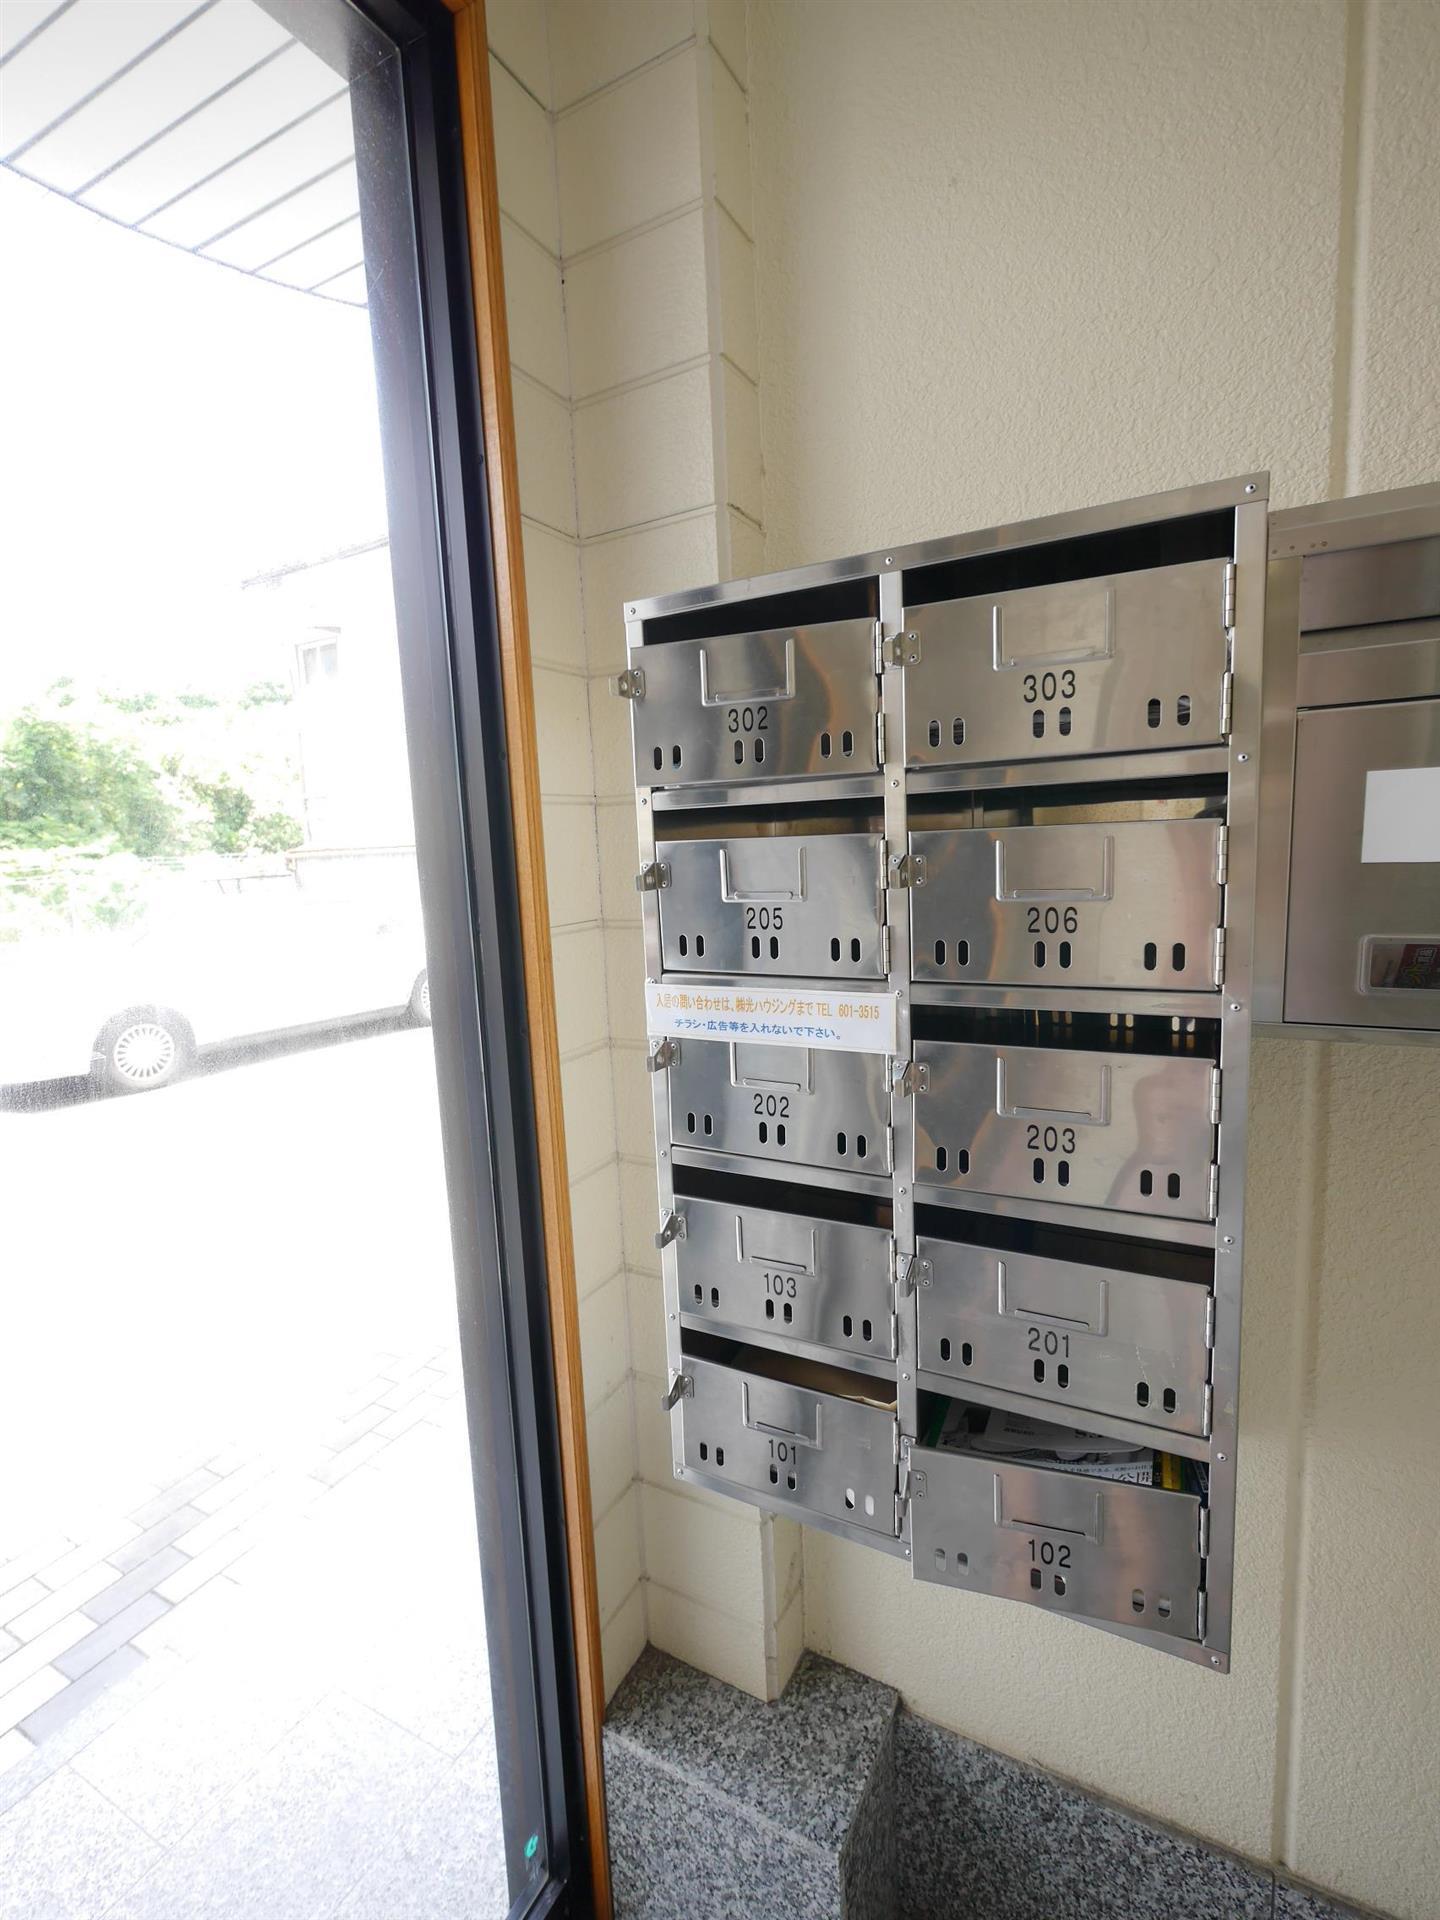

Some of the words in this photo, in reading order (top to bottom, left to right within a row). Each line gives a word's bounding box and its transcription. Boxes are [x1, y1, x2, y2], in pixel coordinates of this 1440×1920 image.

[1023, 669, 1076, 704] 303
[728, 705, 769, 733] 302
[746, 906, 784, 931] 205
[1027, 906, 1078, 934] 206
[816, 1002, 833, 1017] TEL
[838, 1003, 880, 1020] 601-3515
[674, 1018, 841, 1040] チラシ・広告等を入れないで下さい。
[753, 1092, 790, 1119] 202
[1026, 1124, 1076, 1154] 203
[762, 1272, 797, 1299] 103
[1027, 1327, 1070, 1358] 201
[767, 1439, 797, 1466] 101
[1027, 1539, 1072, 1569] 102
